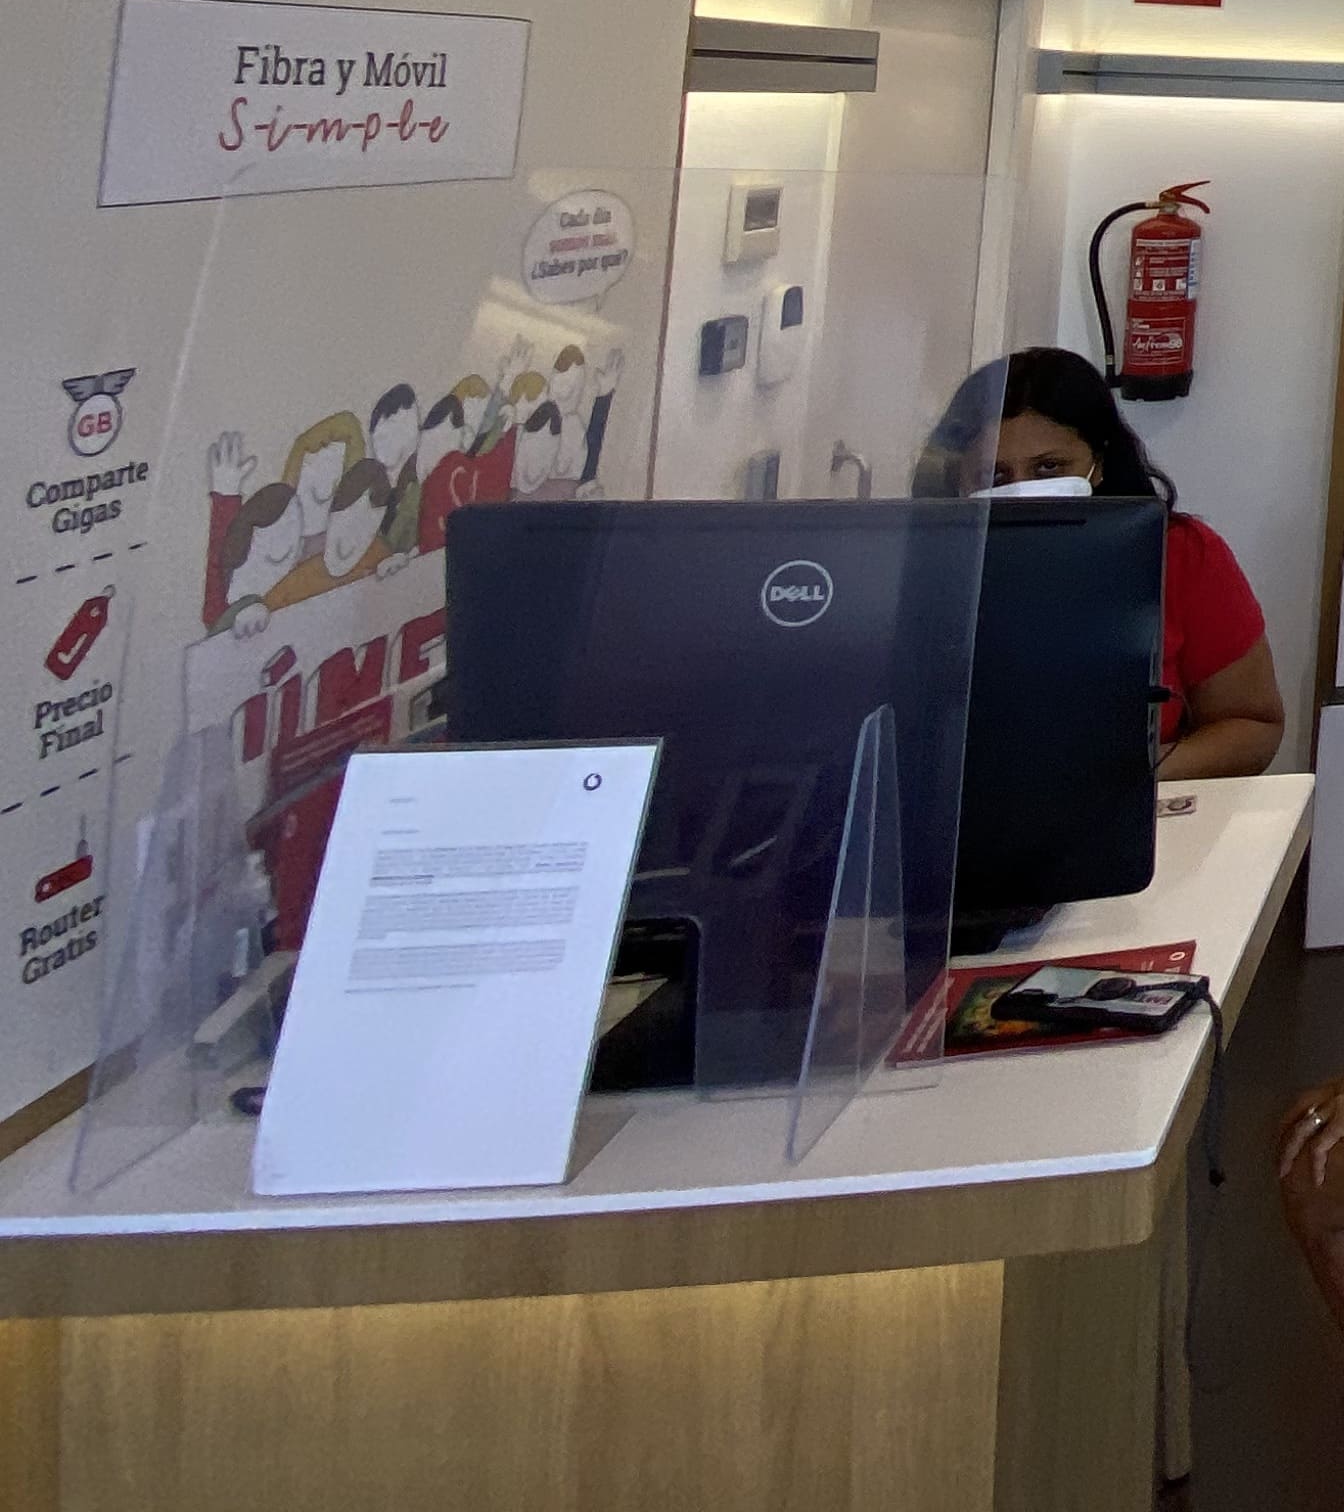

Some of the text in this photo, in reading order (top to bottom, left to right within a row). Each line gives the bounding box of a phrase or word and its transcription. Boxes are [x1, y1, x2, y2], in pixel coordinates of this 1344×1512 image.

[234, 44, 448, 95] Fibra y Móvil
[77, 411, 113, 438] GB
[26, 461, 149, 509] Comparte
[52, 499, 122, 534] Gigas
[770, 585, 825, 602] DELL
[34, 679, 113, 730] Precio
[39, 708, 104, 760] Final
[20, 894, 106, 957] Router
[22, 930, 98, 985] Gratis
